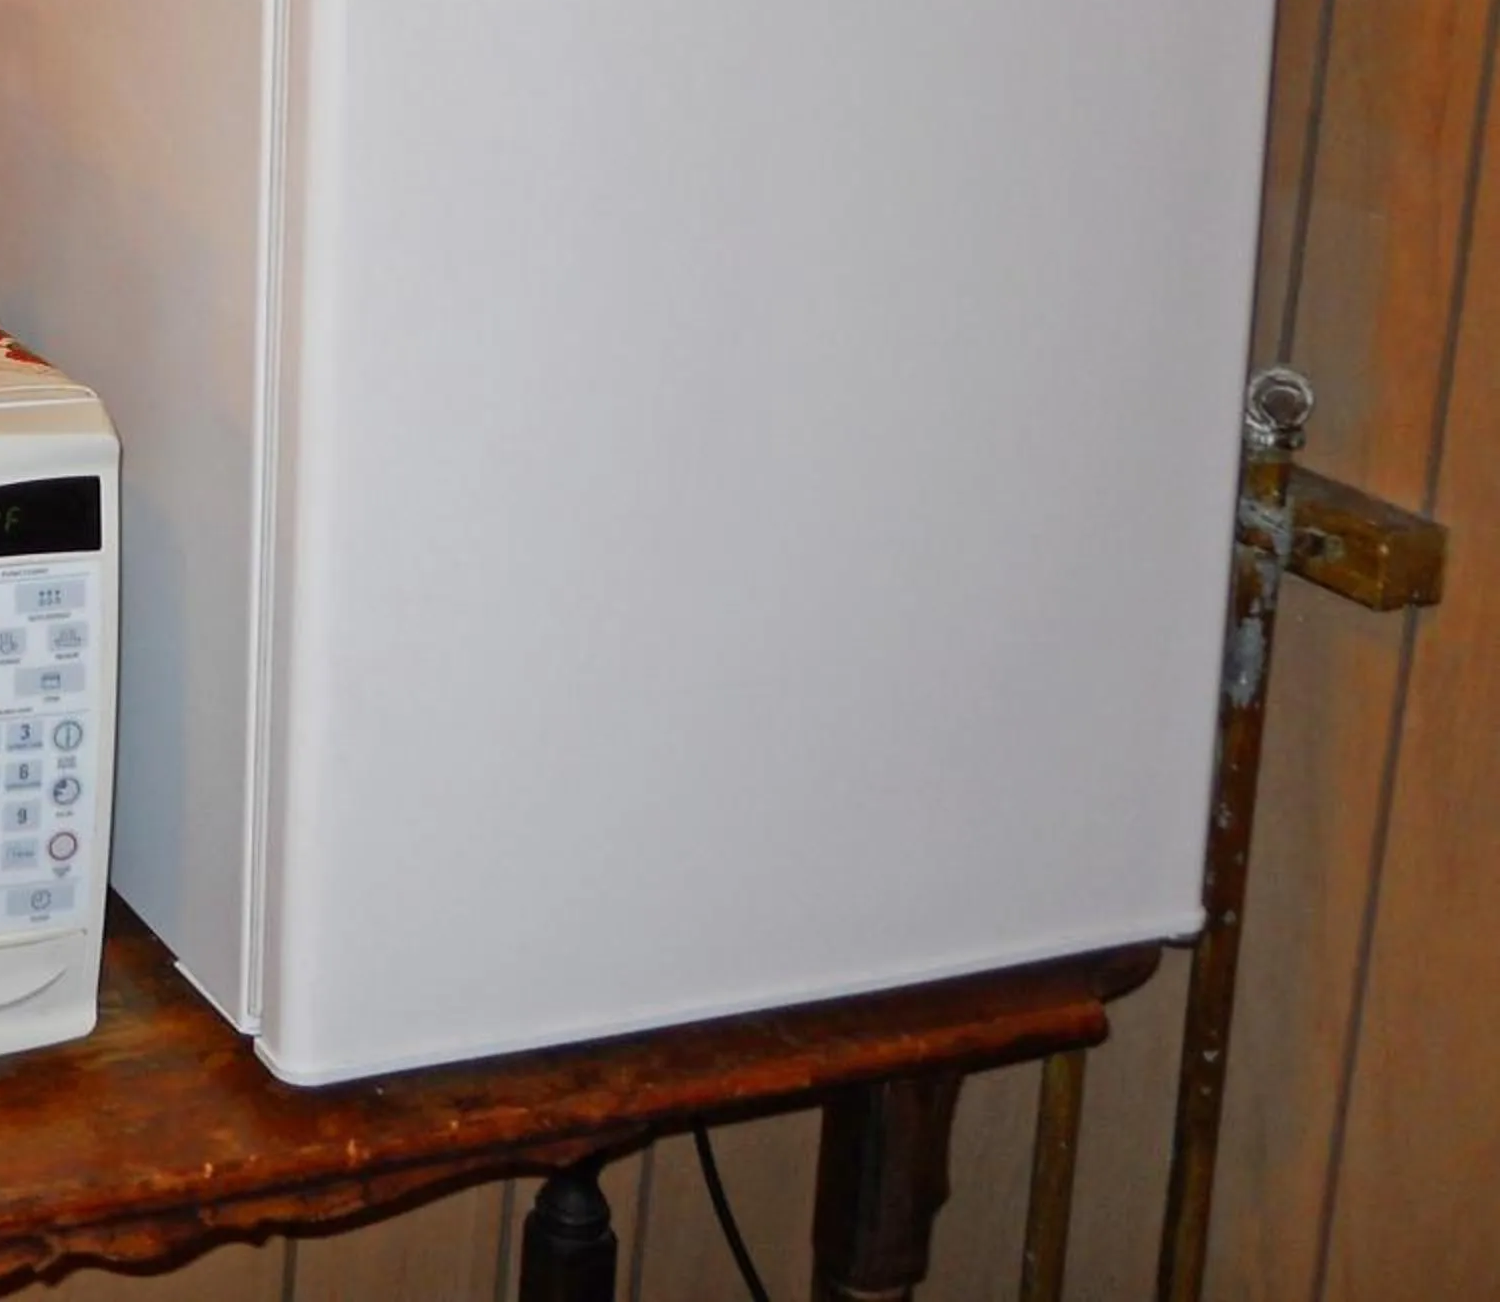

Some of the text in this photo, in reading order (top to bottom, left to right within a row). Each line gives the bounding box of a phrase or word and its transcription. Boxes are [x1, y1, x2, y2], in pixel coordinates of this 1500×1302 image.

[20, 724, 31, 741] 3
[18, 763, 29, 780] 6
[17, 807, 27, 825] 9
